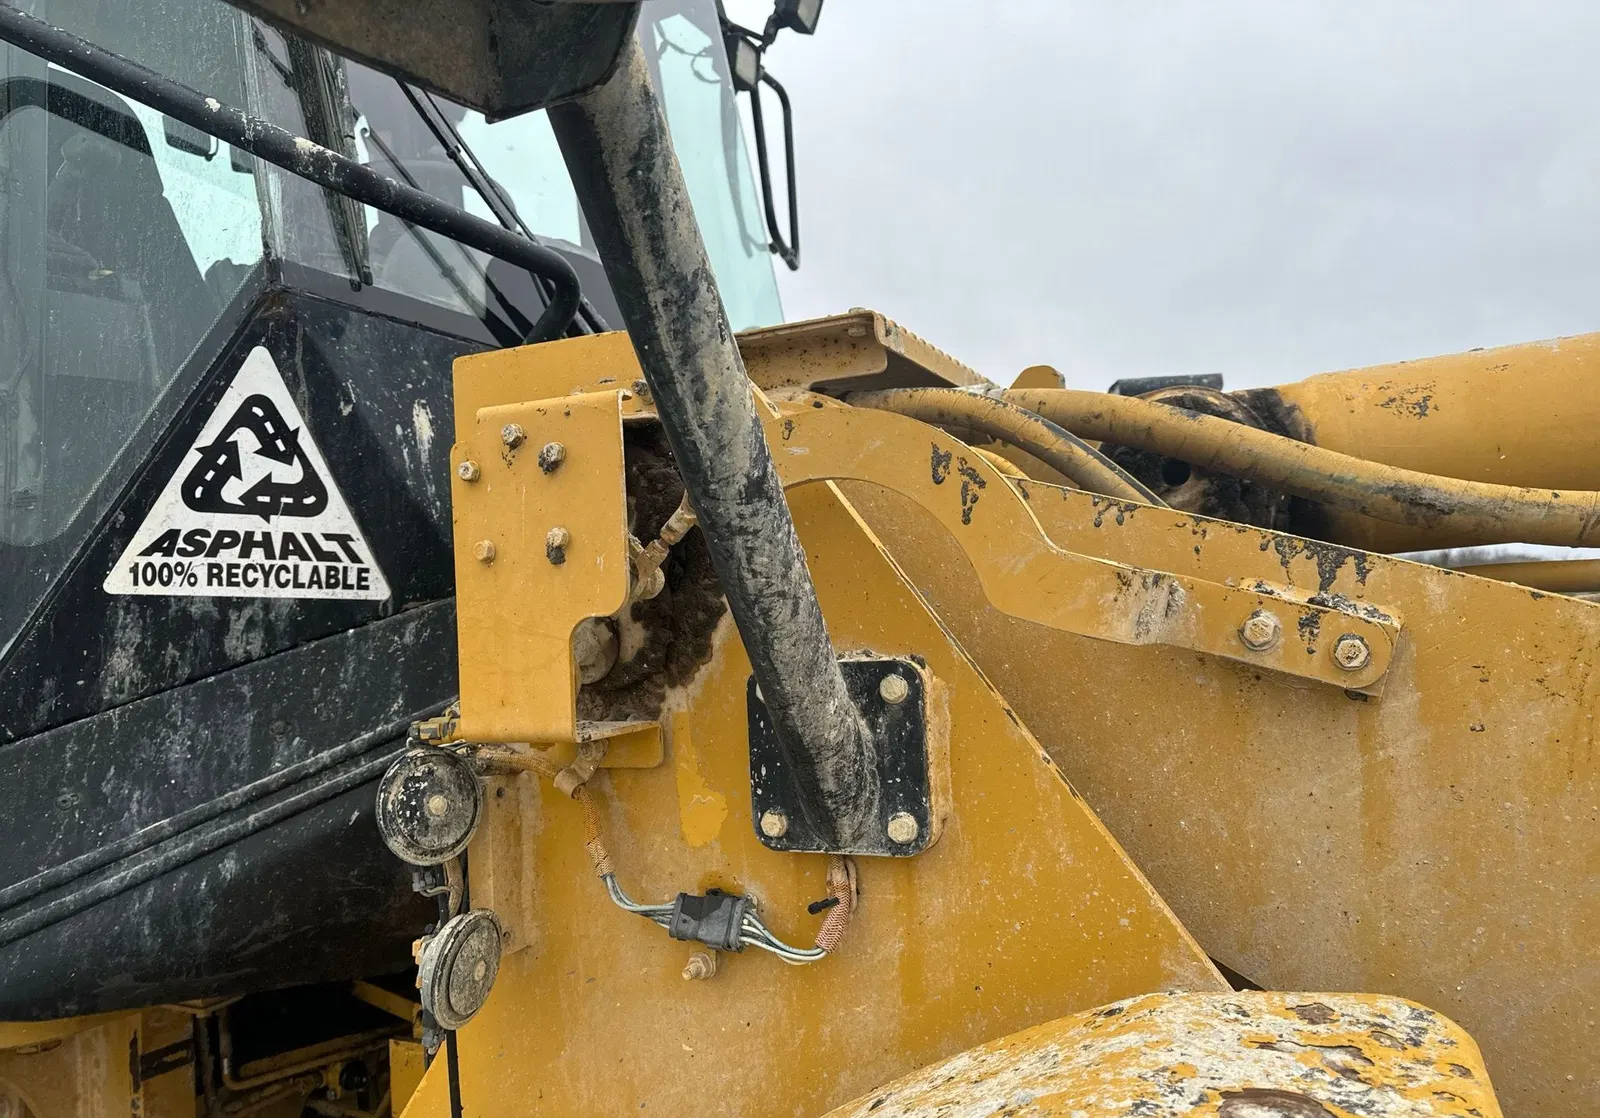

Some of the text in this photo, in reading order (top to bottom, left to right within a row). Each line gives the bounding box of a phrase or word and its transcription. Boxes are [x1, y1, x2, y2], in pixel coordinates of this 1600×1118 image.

[137, 528, 364, 564] ASPHALT
[129, 561, 370, 590] 100% RECYCLABLE
